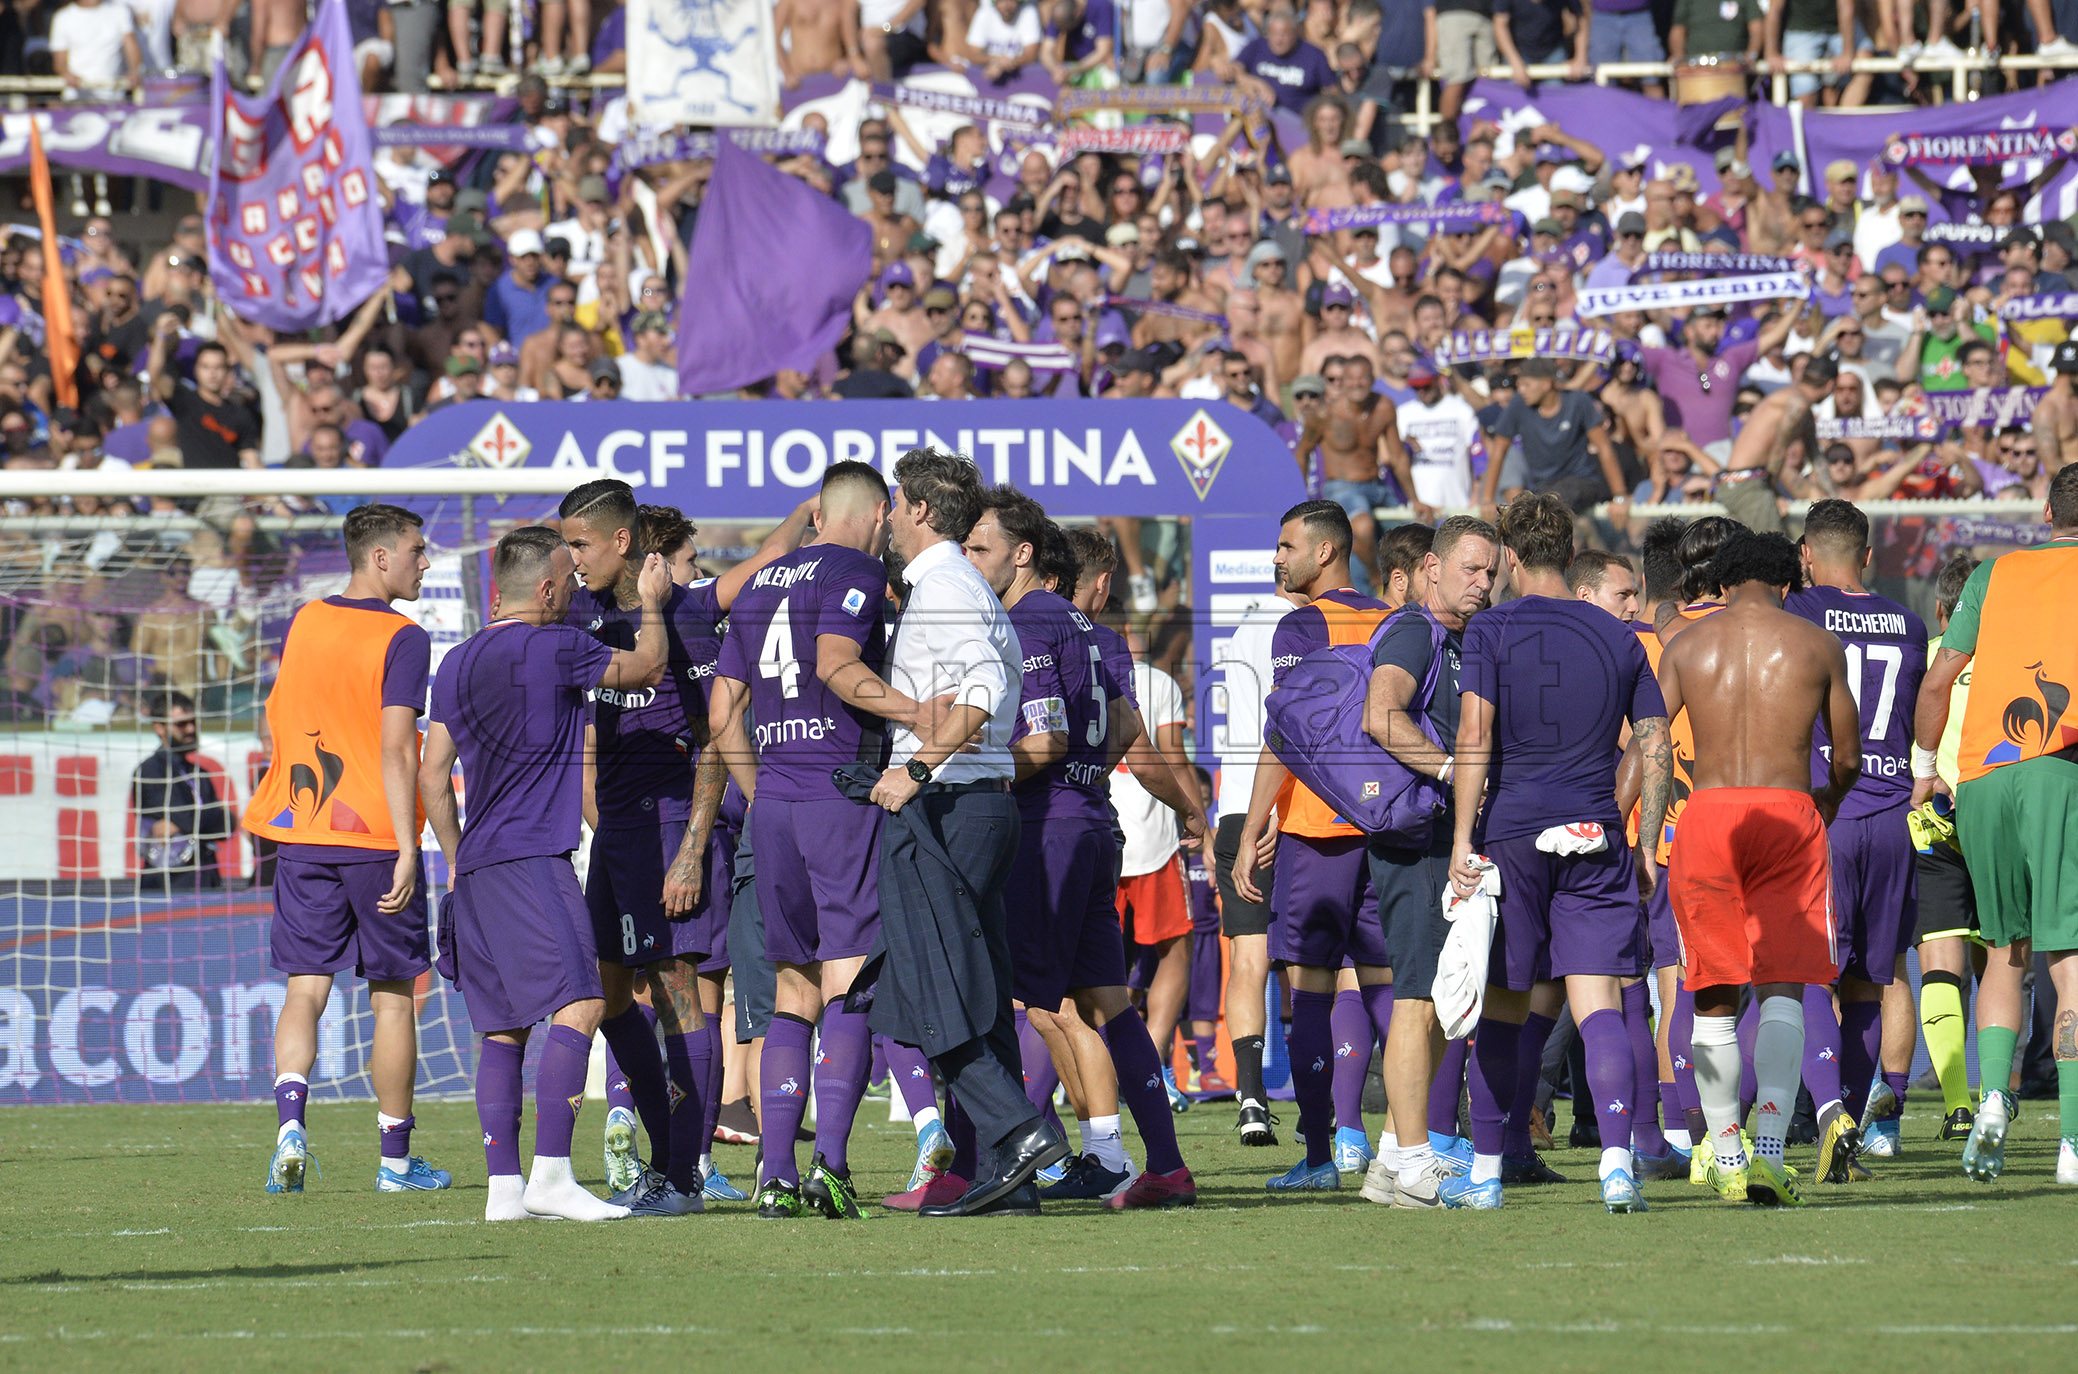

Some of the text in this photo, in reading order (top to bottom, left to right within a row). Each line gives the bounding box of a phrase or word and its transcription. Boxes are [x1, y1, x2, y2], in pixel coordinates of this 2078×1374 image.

[895, 84, 1039, 123] FIORENTINA
[1907, 131, 2057, 158] FIORENTINA
[1649, 252, 1790, 272] FIORENTINA
[1582, 277, 1802, 313] JUVE MERDA
[551, 429, 689, 487] ACF
[1215, 562, 1275, 577] Mediaco
[1825, 609, 1907, 635] CECCHERINI
[758, 596, 801, 699] 4
[1022, 653, 1054, 674] stra
[1086, 645, 1108, 748] 5
[1844, 643, 1903, 741] 17
[755, 716, 836, 755] prima.it
